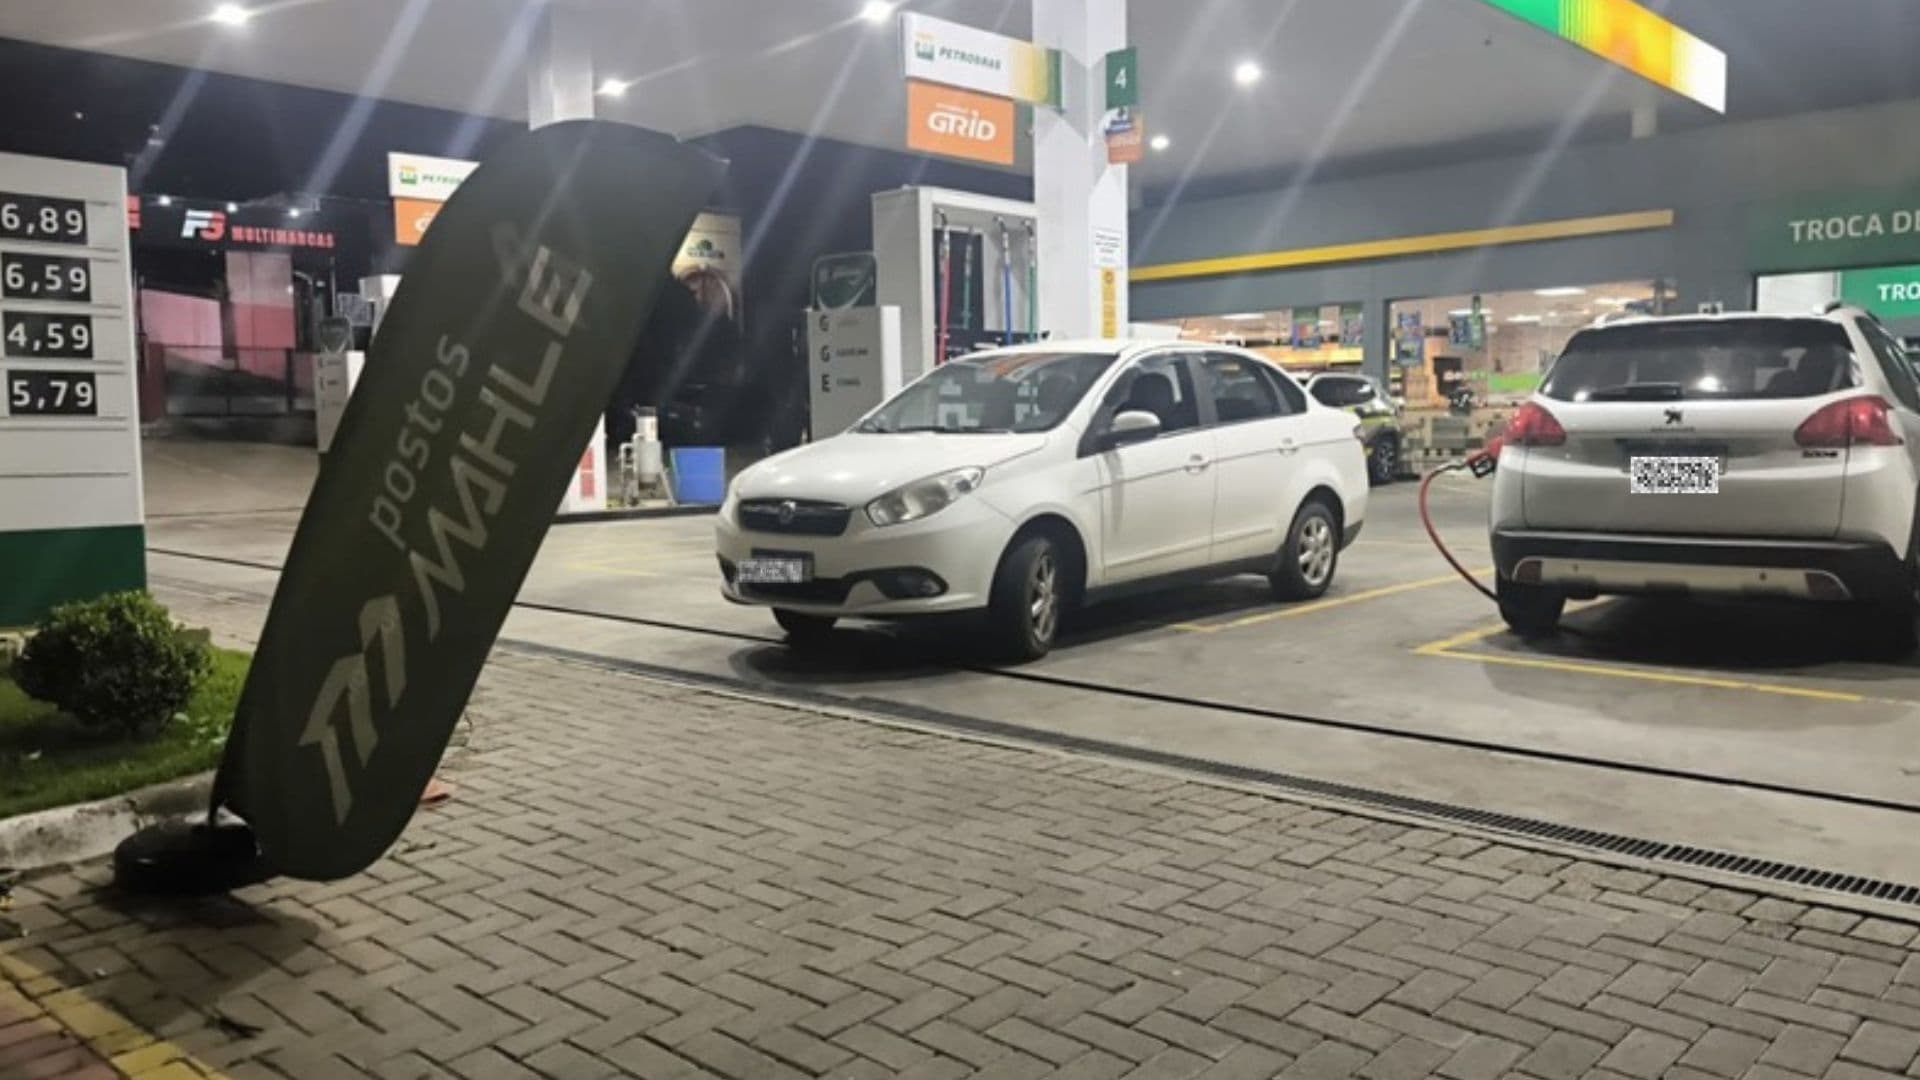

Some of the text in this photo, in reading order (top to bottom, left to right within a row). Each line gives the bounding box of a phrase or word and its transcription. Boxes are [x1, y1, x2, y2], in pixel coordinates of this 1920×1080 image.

[939, 45, 1001, 70] PETROBRAS
[1114, 66, 1127, 89] 4
[1, 203, 84, 236] 6,89
[1788, 212, 1885, 243] TROCA
[231, 225, 335, 249] MULTIMARCAS
[6, 263, 87, 293] 6,59
[7, 322, 89, 351] 4,59
[13, 381, 94, 409] 5,79
[369, 334, 470, 550] postos
[409, 245, 593, 643] MAHLE
